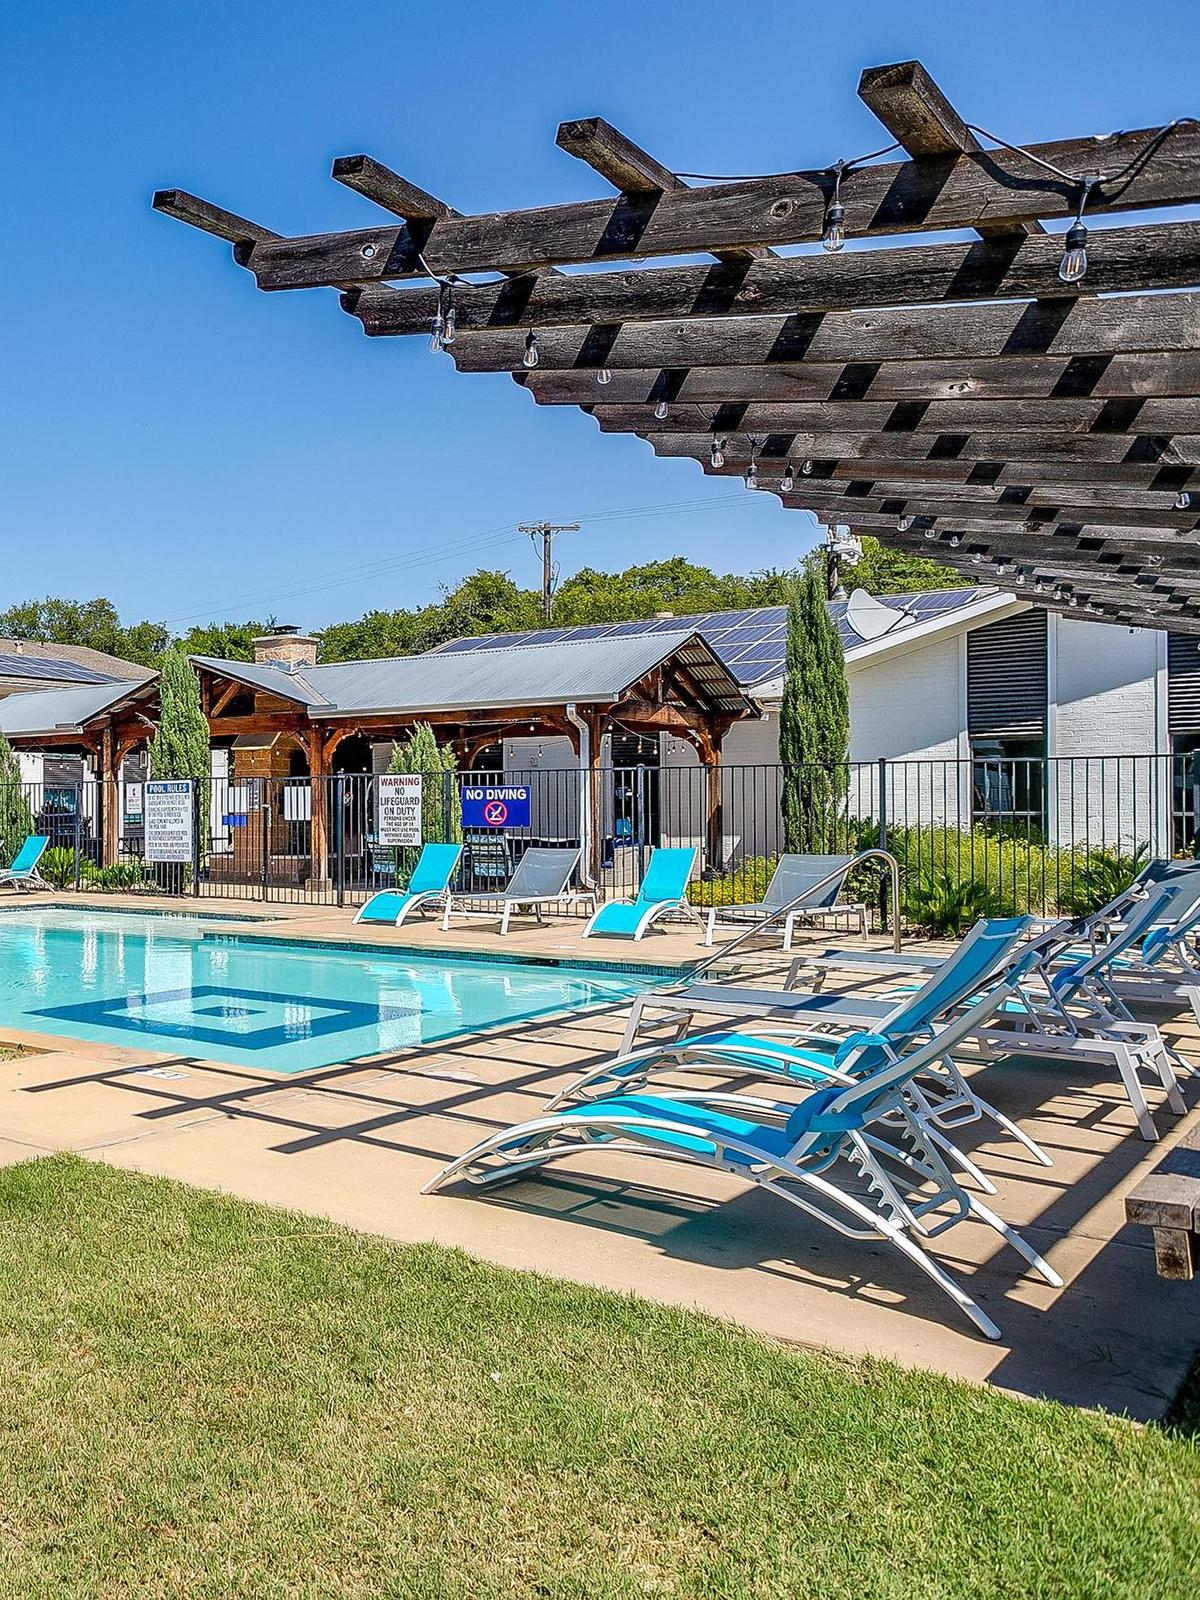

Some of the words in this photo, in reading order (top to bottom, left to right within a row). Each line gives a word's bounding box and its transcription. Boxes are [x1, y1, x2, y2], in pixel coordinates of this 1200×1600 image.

[380, 777, 420, 786] WARNING
[149, 784, 165, 793] POOL
[167, 783, 187, 793] RULES
[394, 787, 405, 796] NO
[466, 789, 483, 800] NO
[485, 788, 527, 800] DIVING
[380, 797, 420, 806] LIFEGUARD
[384, 807, 394, 815] ON
[396, 806, 416, 815] DUTY
